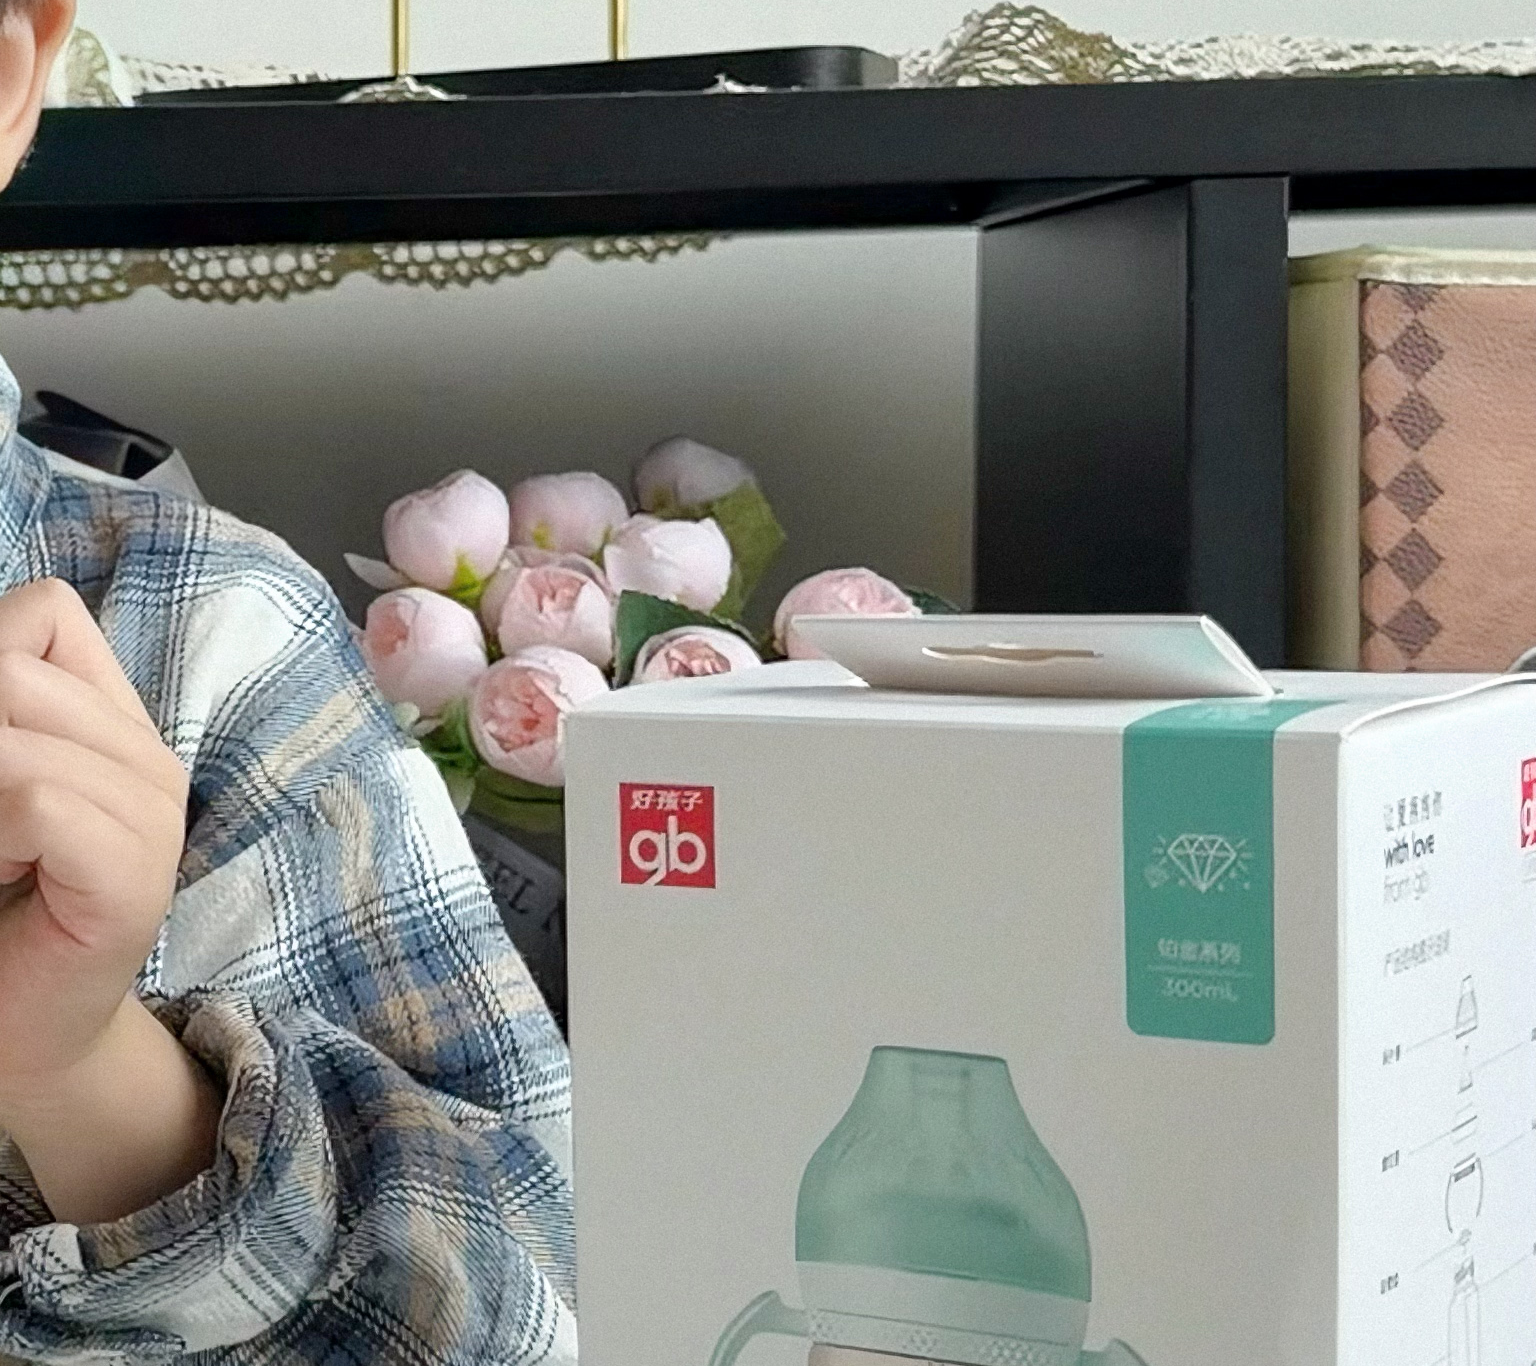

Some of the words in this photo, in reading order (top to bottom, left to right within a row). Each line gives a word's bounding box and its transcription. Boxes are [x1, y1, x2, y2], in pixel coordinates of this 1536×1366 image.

[630, 788, 704, 812] 好孩子
[629, 814, 707, 886] gb
